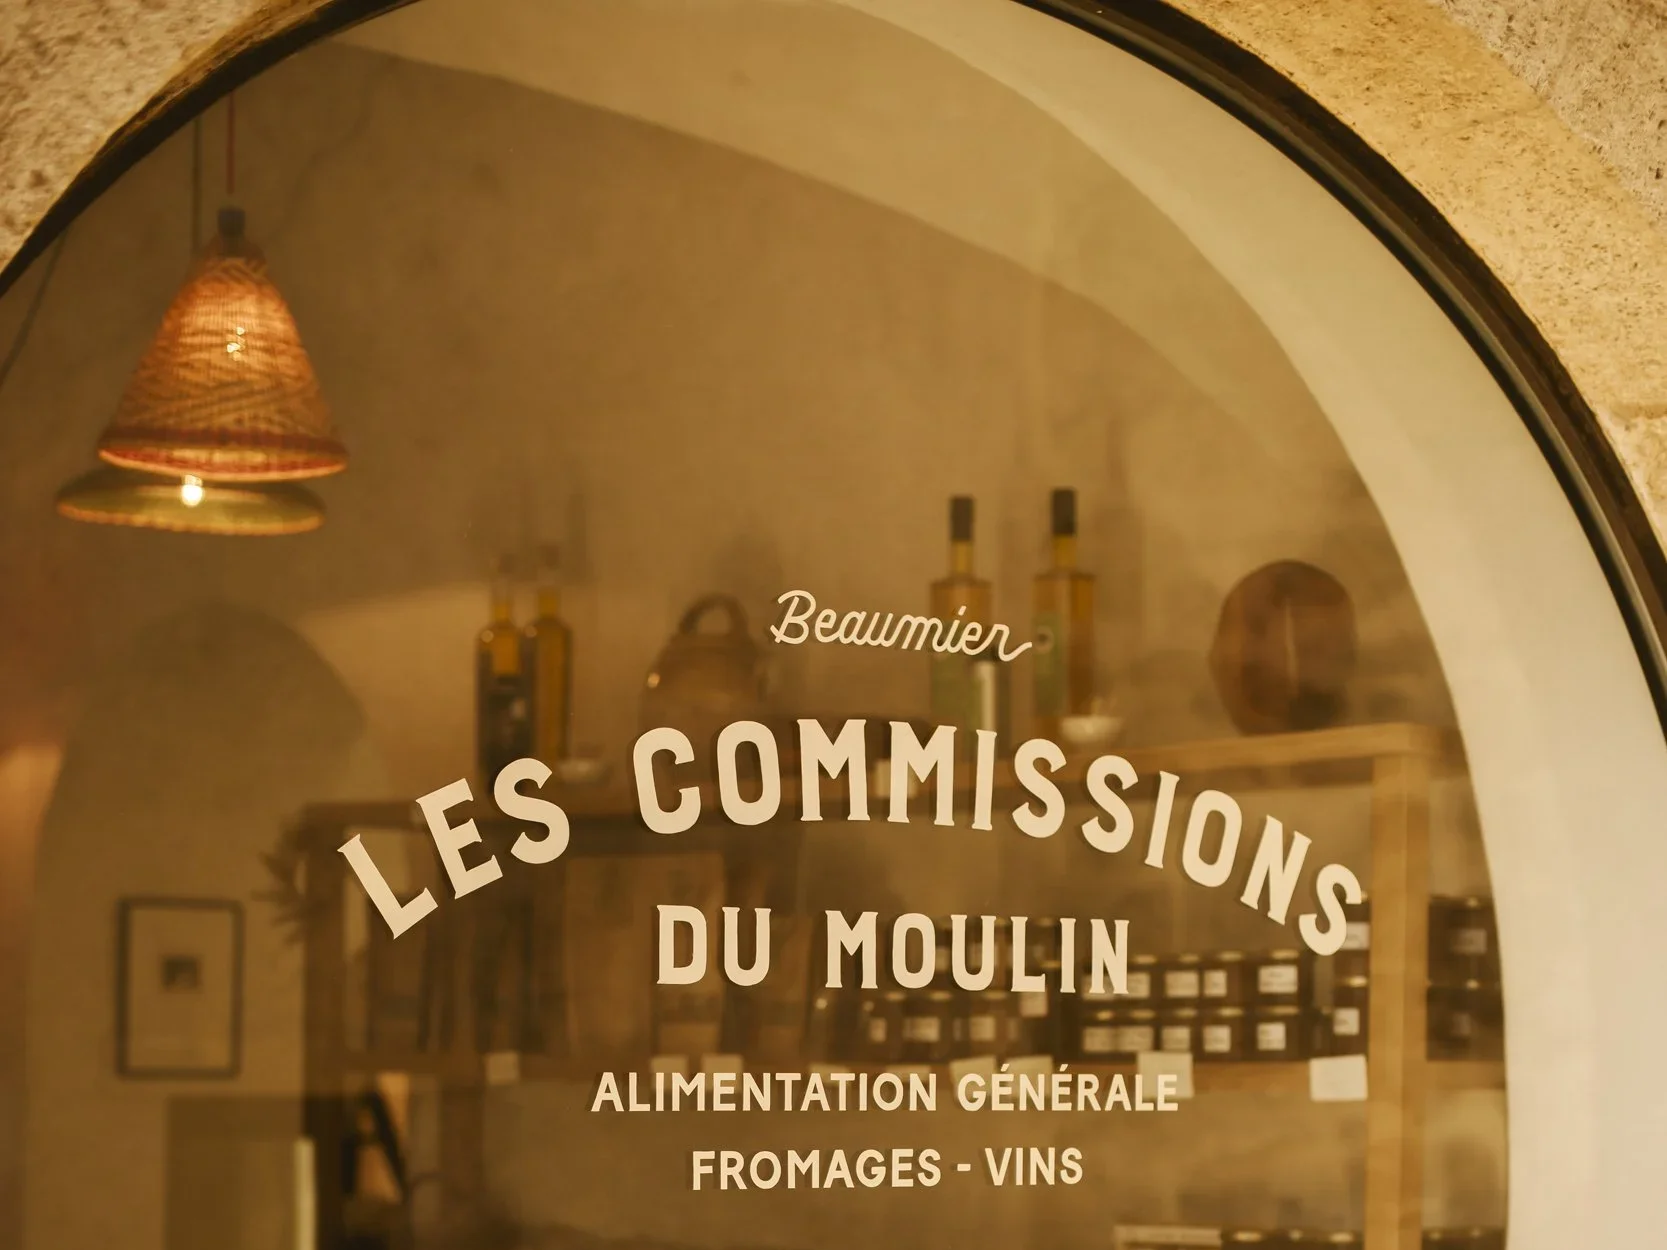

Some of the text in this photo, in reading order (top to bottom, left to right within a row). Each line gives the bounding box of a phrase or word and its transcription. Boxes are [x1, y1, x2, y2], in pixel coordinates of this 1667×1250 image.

[771, 589, 1032, 662] Beaumier
[337, 718, 1363, 956] LES COMMISSIONS
[656, 904, 1130, 995] DU MOULIN
[591, 1063, 1179, 1112] ALIMENTATION GÉNÉRALE
[692, 1147, 942, 1190] FROMAGES
[985, 1146, 1084, 1187] VINS
